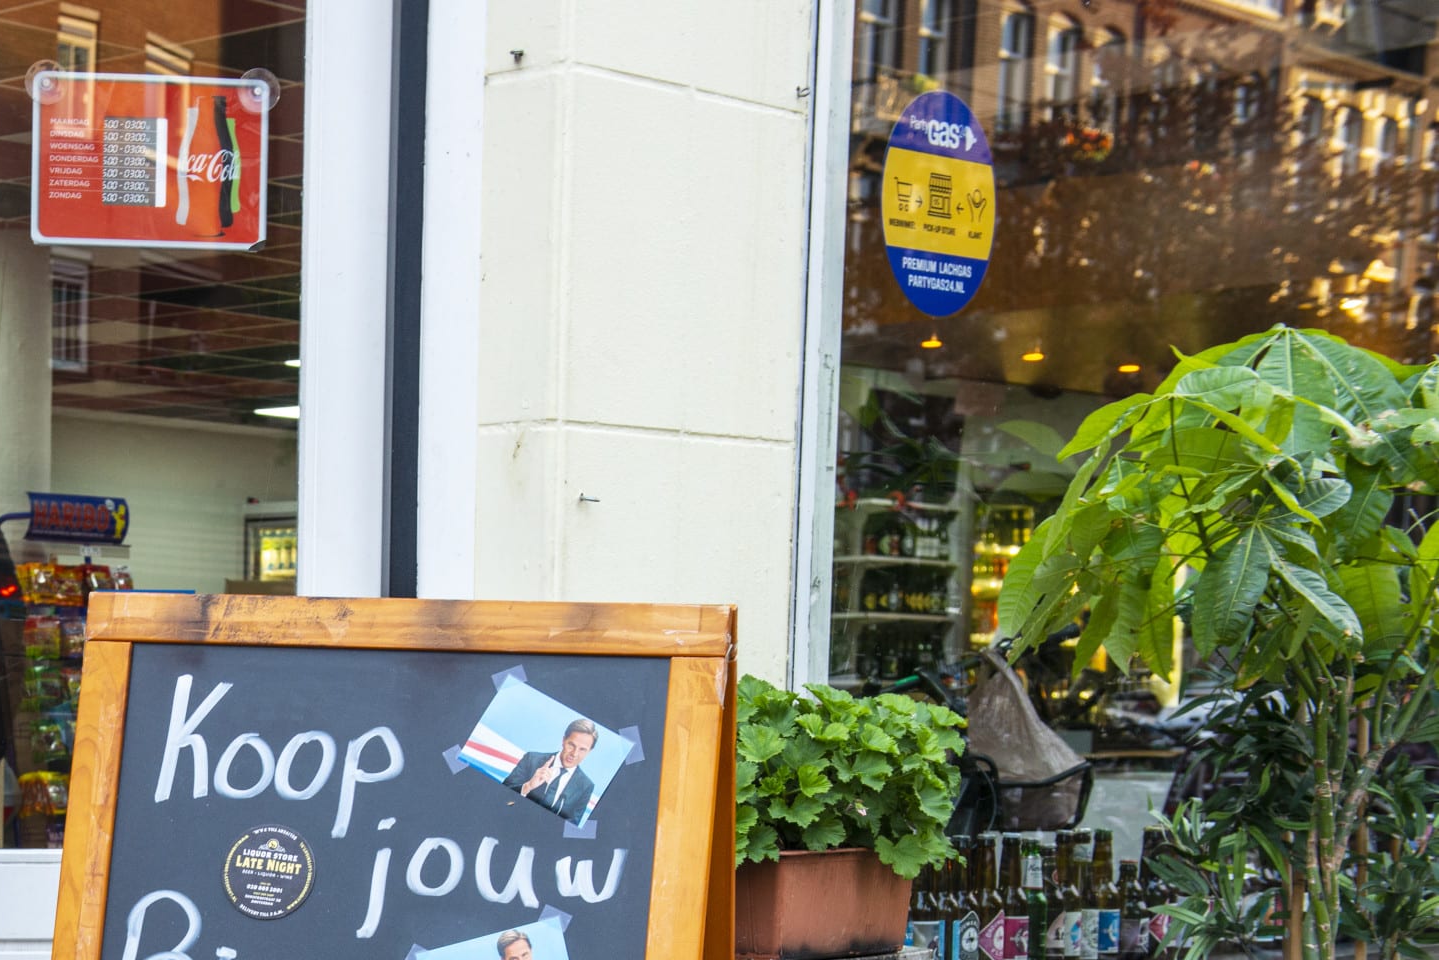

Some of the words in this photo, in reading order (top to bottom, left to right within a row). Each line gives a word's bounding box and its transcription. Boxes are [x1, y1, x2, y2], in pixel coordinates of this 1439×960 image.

[49, 118, 89, 126] MAANDAG
[49, 143, 95, 151] WOENSDAG
[49, 155, 99, 163] DONDERDAG
[49, 167, 82, 175] VRIJDAG
[49, 179, 90, 187] ZATERDAG
[49, 191, 82, 199] ZONDAG
[902, 256, 937, 273] PREMIUM
[939, 262, 972, 278] LACHGAS
[908, 274, 965, 294] PARTYGAS24.NL
[34, 501, 110, 532] HARIBO
[154, 674, 405, 839] Koop
[243, 848, 272, 859] LIQUOR
[273, 852, 298, 862] STORE
[235, 855, 264, 870] LATE
[266, 859, 302, 875] NIGHT
[356, 817, 629, 938] jouw
